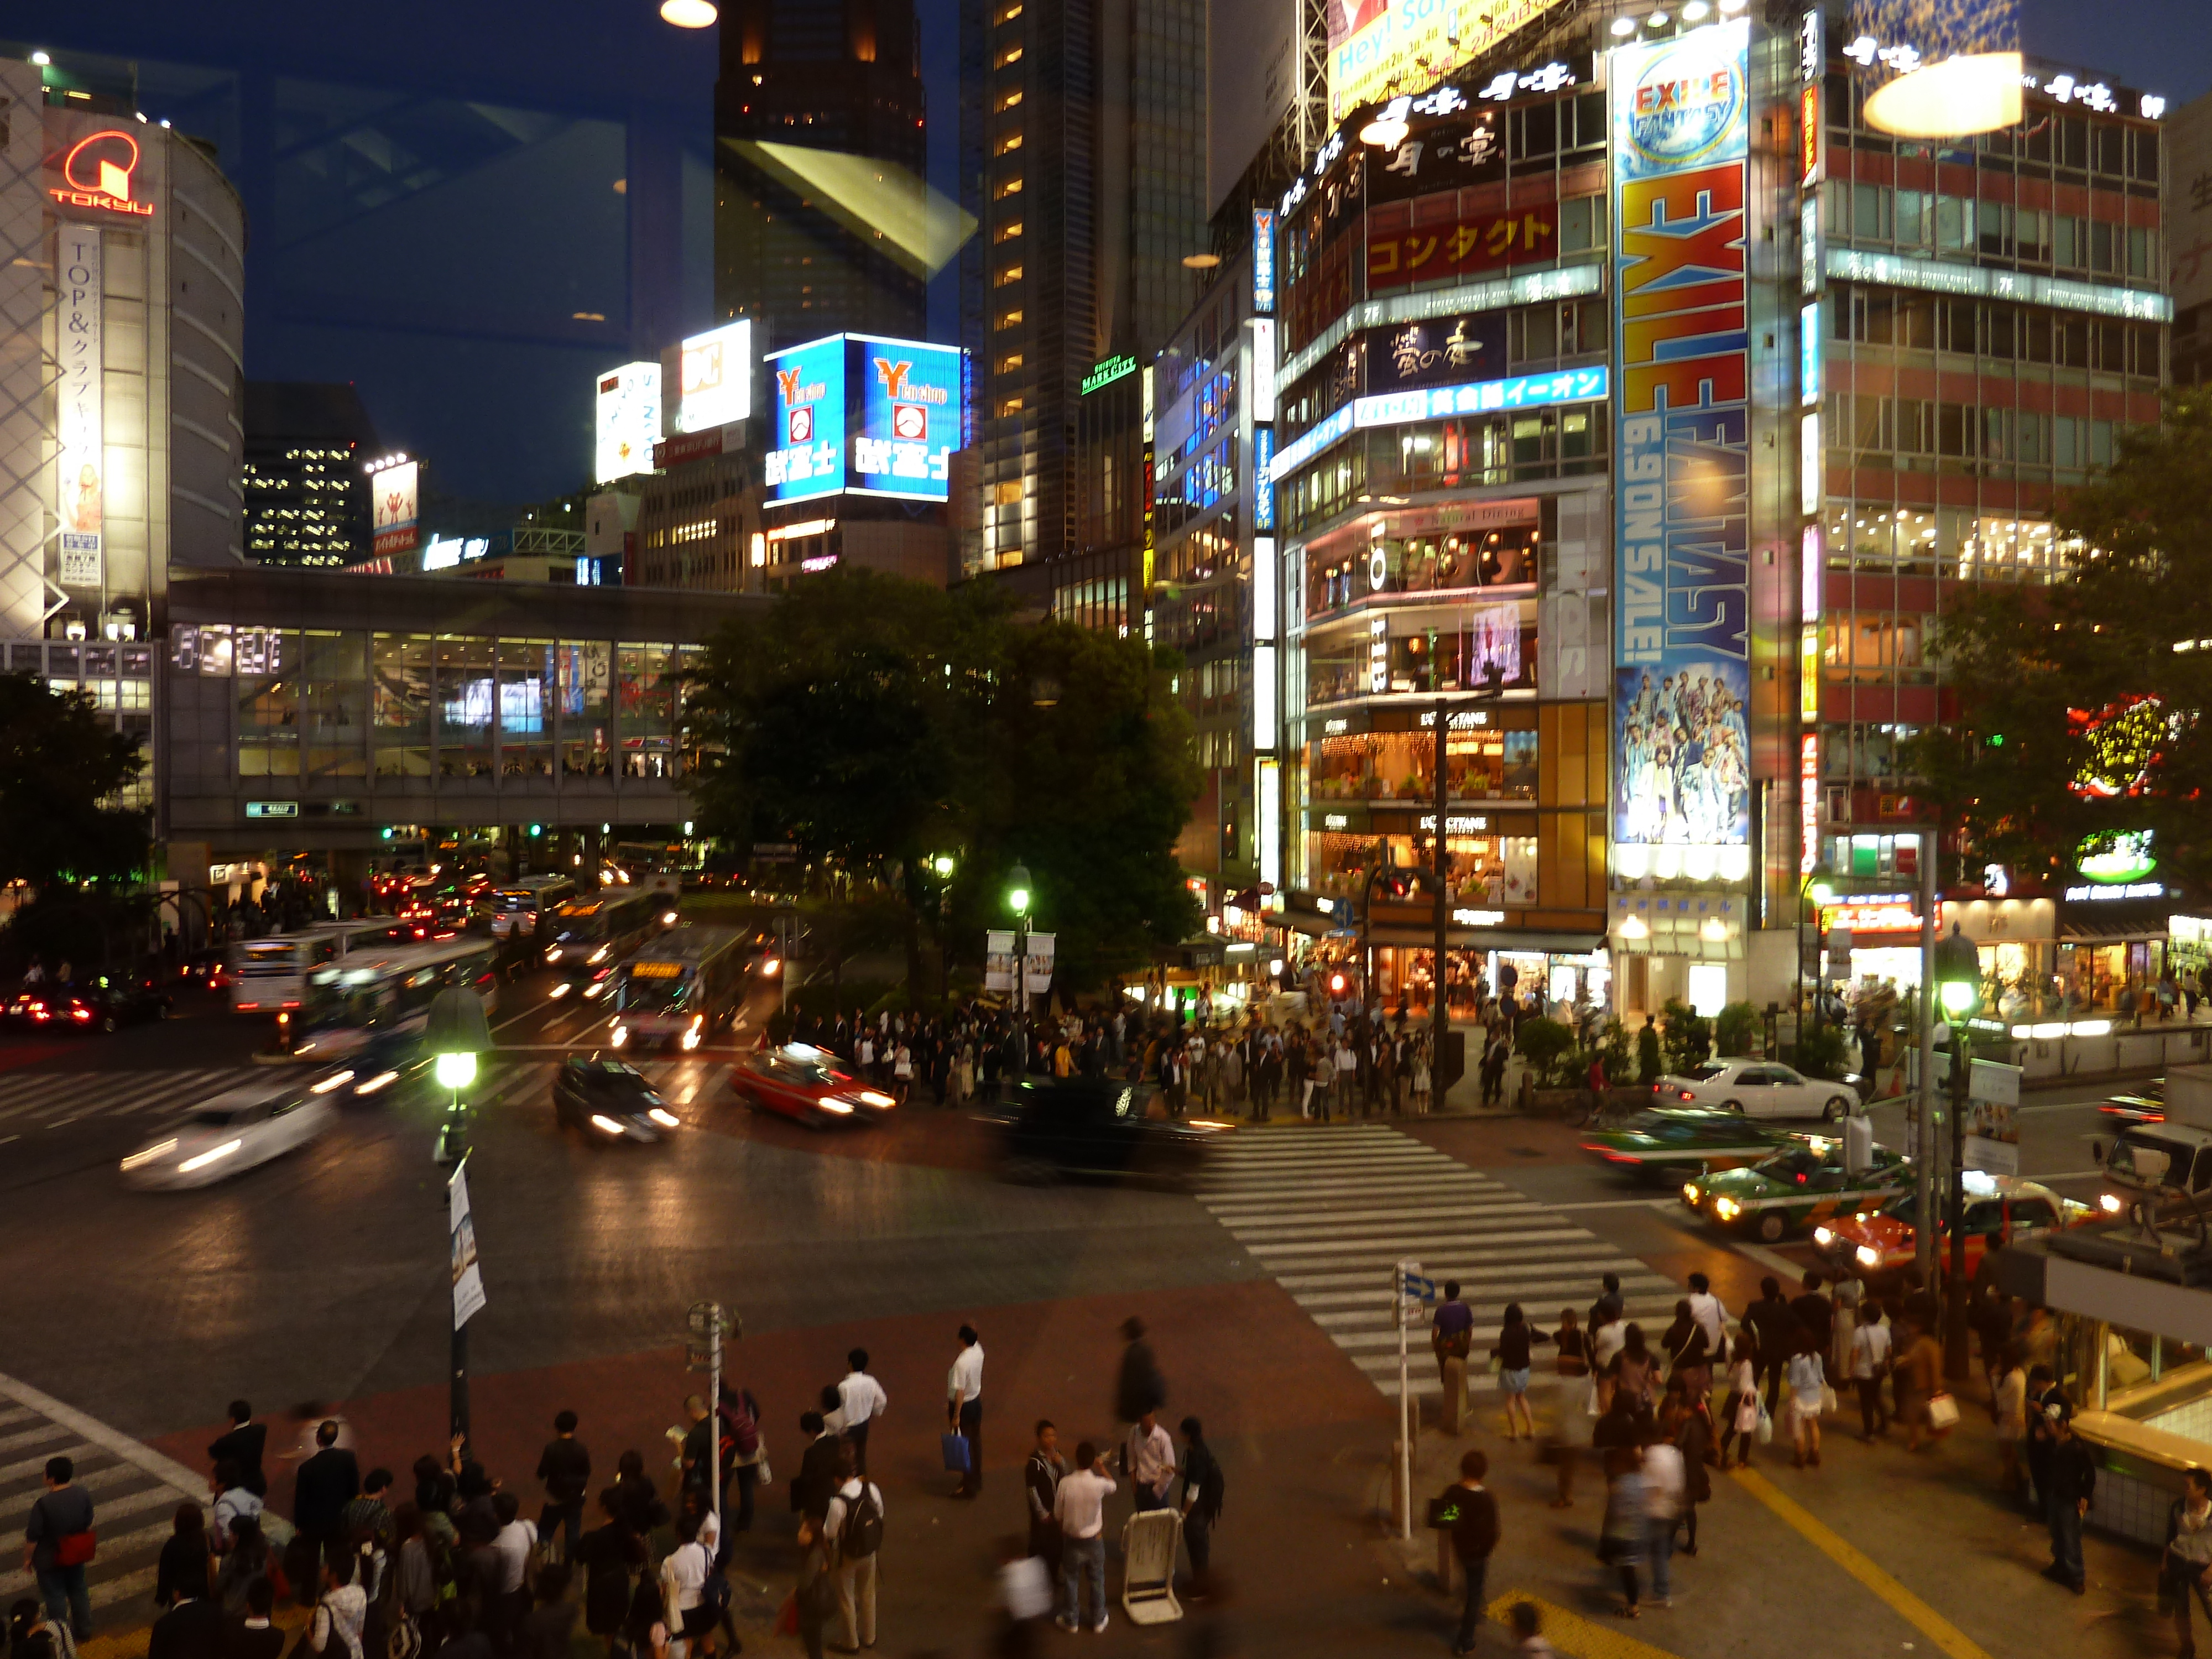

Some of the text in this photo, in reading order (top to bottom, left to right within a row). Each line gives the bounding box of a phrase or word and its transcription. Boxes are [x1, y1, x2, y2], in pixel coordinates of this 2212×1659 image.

[1339, 14, 1391, 79] Hey!
[1636, 69, 1730, 118] EXILE
[1635, 101, 1727, 138] FANTASY
[49, 188, 153, 215] TOKYU
[1369, 212, 1552, 275] コンタクト
[1621, 159, 1746, 414] EXILE
[1999, 277, 2013, 294] 7F
[1364, 306, 1380, 324] 7F
[683, 343, 719, 392] DC
[1082, 356, 1135, 391] MARK CITY
[1094, 354, 1121, 374] SHIBUYA
[919, 384, 947, 405] shop
[1432, 374, 1599, 414] 英会話イーオン
[765, 441, 837, 486] 武富士
[1431, 510, 1475, 526] Natural
[1624, 483, 1662, 538] ON
[1666, 405, 1749, 662] FANTASY
[1624, 544, 1662, 662] SALE!
